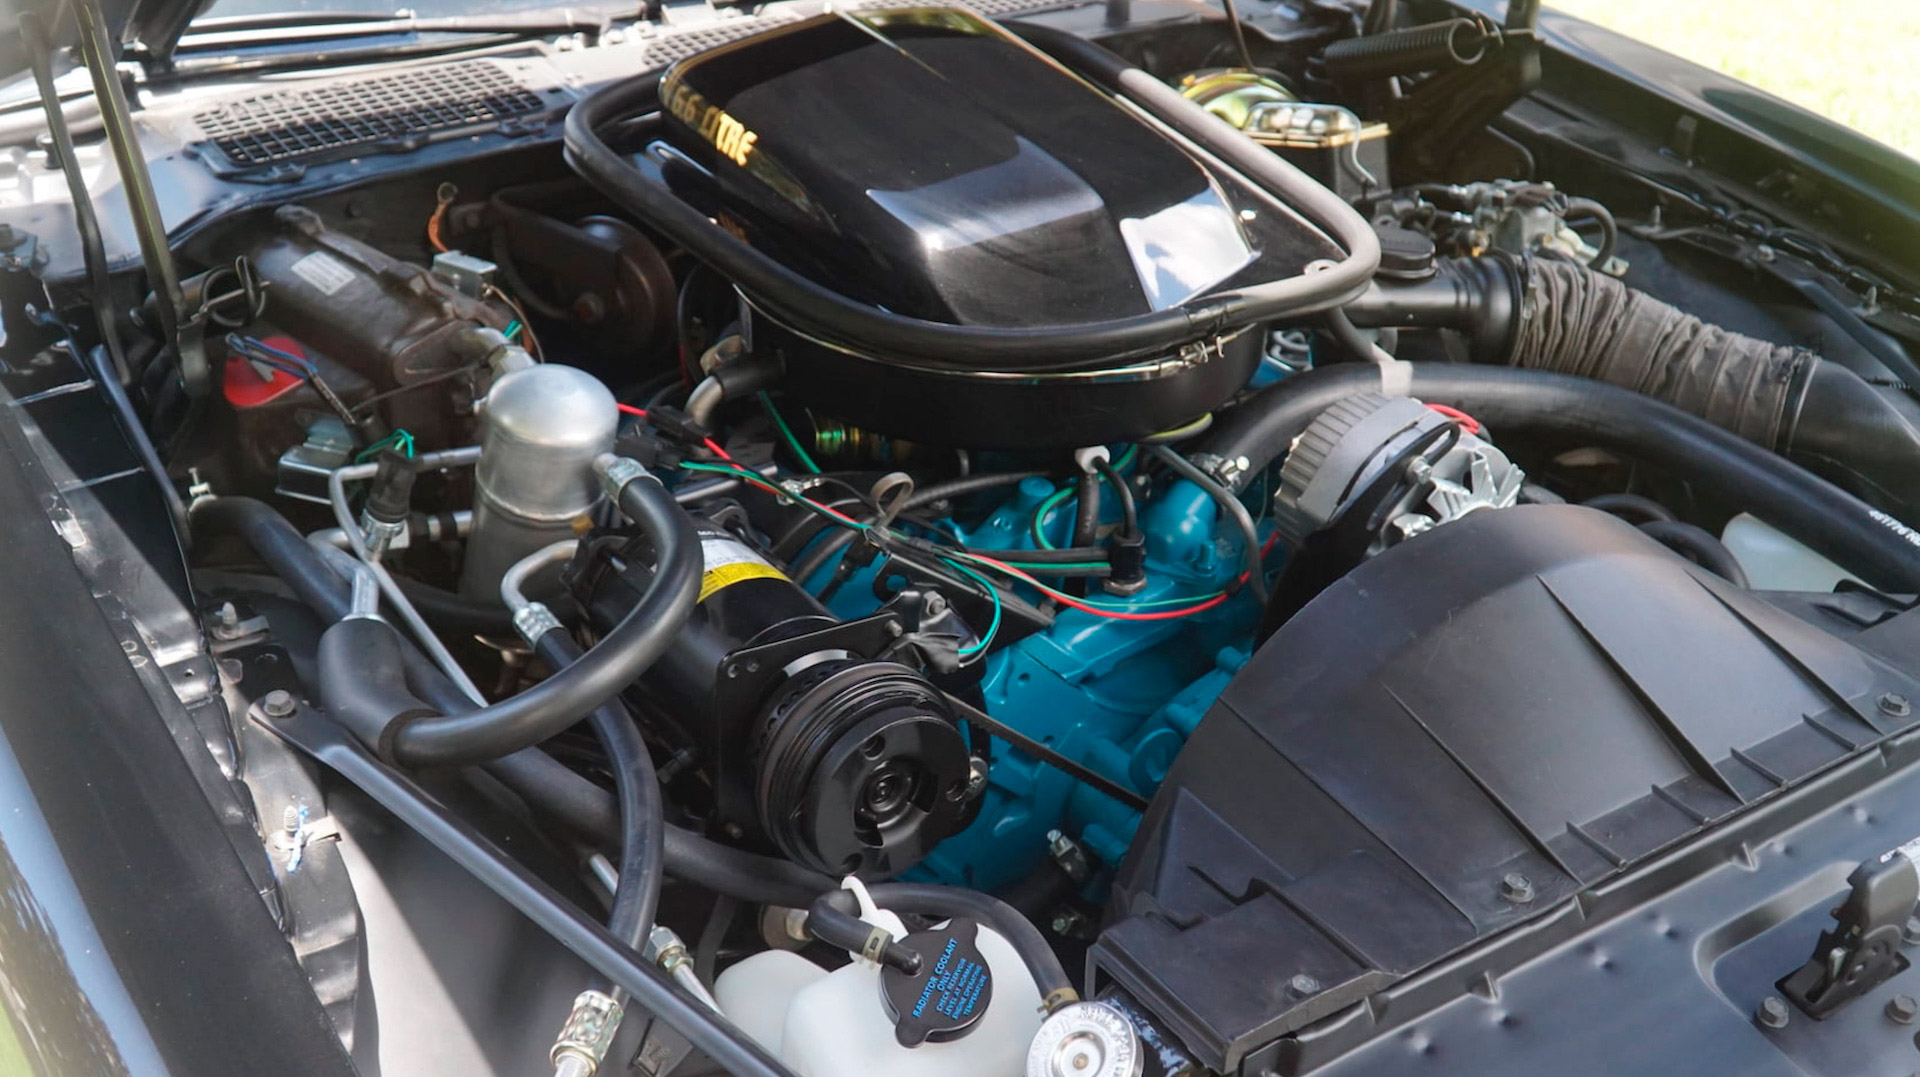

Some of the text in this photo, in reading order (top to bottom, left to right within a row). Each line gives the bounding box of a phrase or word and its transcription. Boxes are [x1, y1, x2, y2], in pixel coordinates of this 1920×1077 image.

[698, 106, 758, 167] LITRE
[912, 938, 958, 1018] RADIATOR COOLANT
[936, 970, 952, 991] ONLY
[936, 957, 967, 1012] CHECK RESERVOIR
[944, 962, 975, 1016] LEVEL AT NORMAL
[951, 965, 983, 1020] ENGINE OPERATING
[963, 975, 988, 1016] TEMPERATURE
